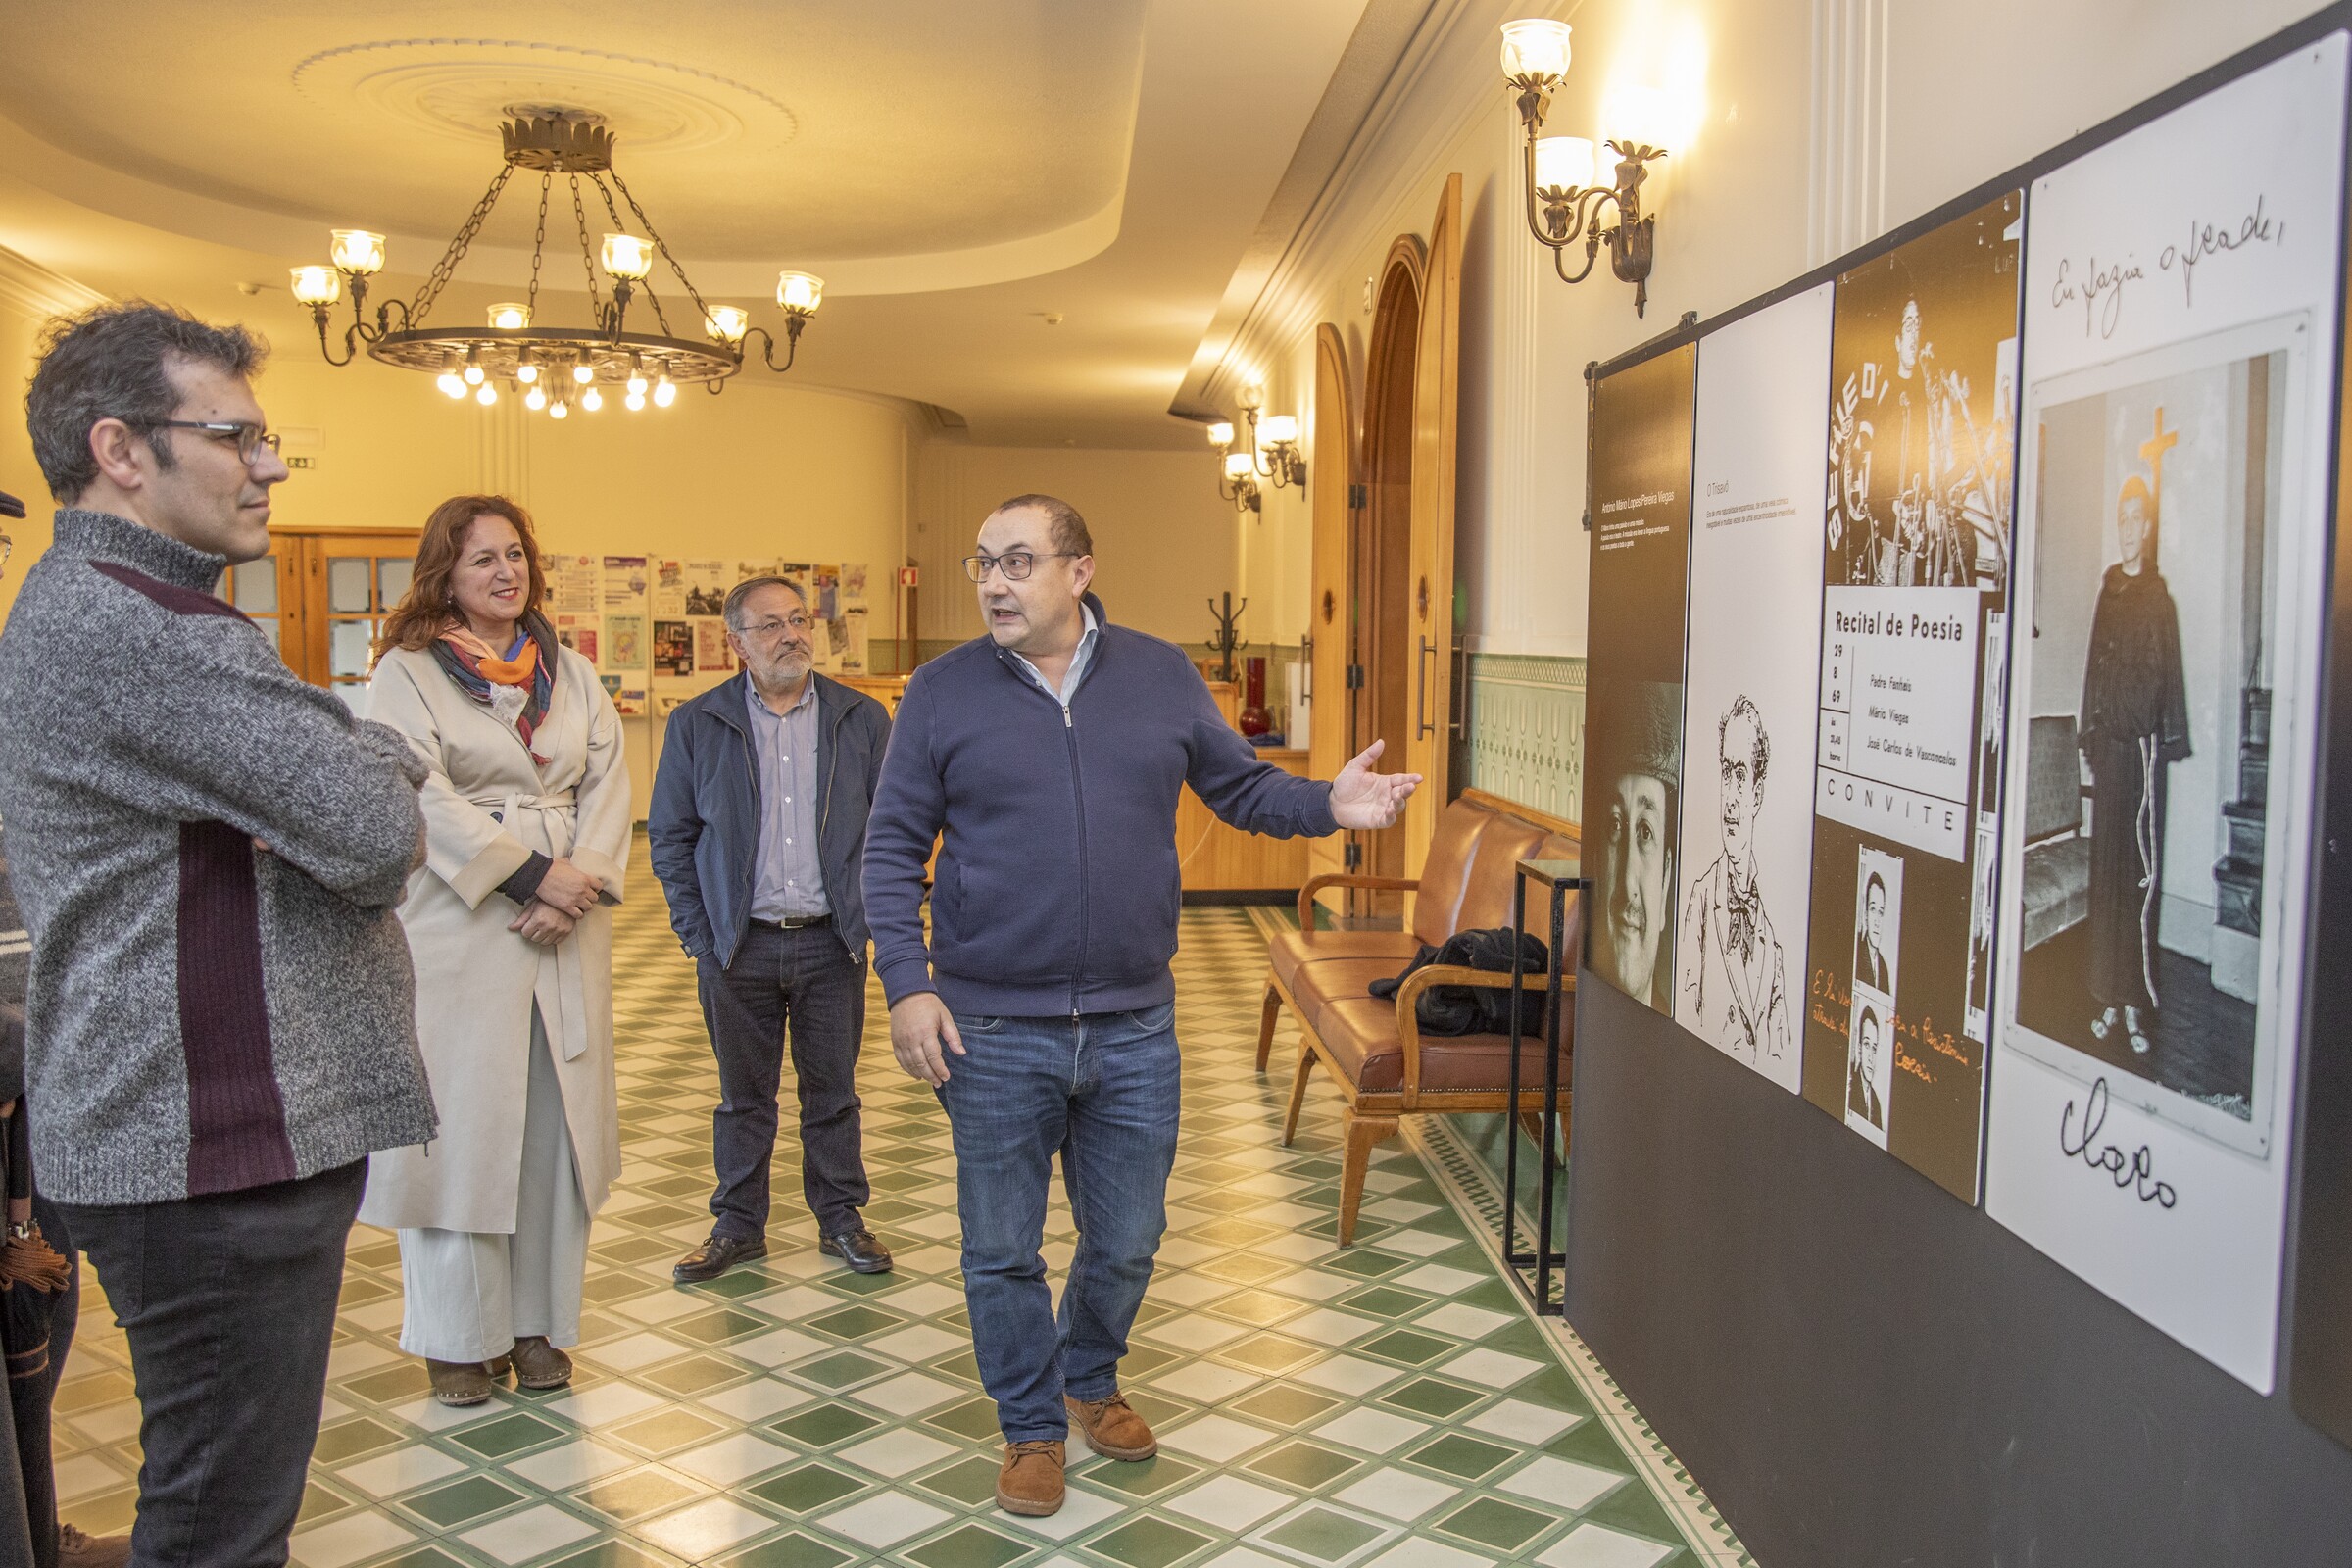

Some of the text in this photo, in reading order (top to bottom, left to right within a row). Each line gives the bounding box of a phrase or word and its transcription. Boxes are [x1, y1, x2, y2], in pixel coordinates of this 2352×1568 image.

[1628, 497, 1642, 510] Lopes
[1642, 493, 1658, 506] Pereira
[1658, 490, 1675, 505] Viegas
[1836, 610, 1963, 642] Recital de Poesia
[1834, 644, 1843, 658] 29
[1833, 666, 1838, 680] 8
[1869, 674, 1886, 690] Padre
[1832, 689, 1841, 704] 69
[1868, 705, 1910, 725] Mário Viegas
[1867, 735, 1957, 767] José Carlos de Vasconcelos
[1827, 778, 1953, 831] CONVITE
